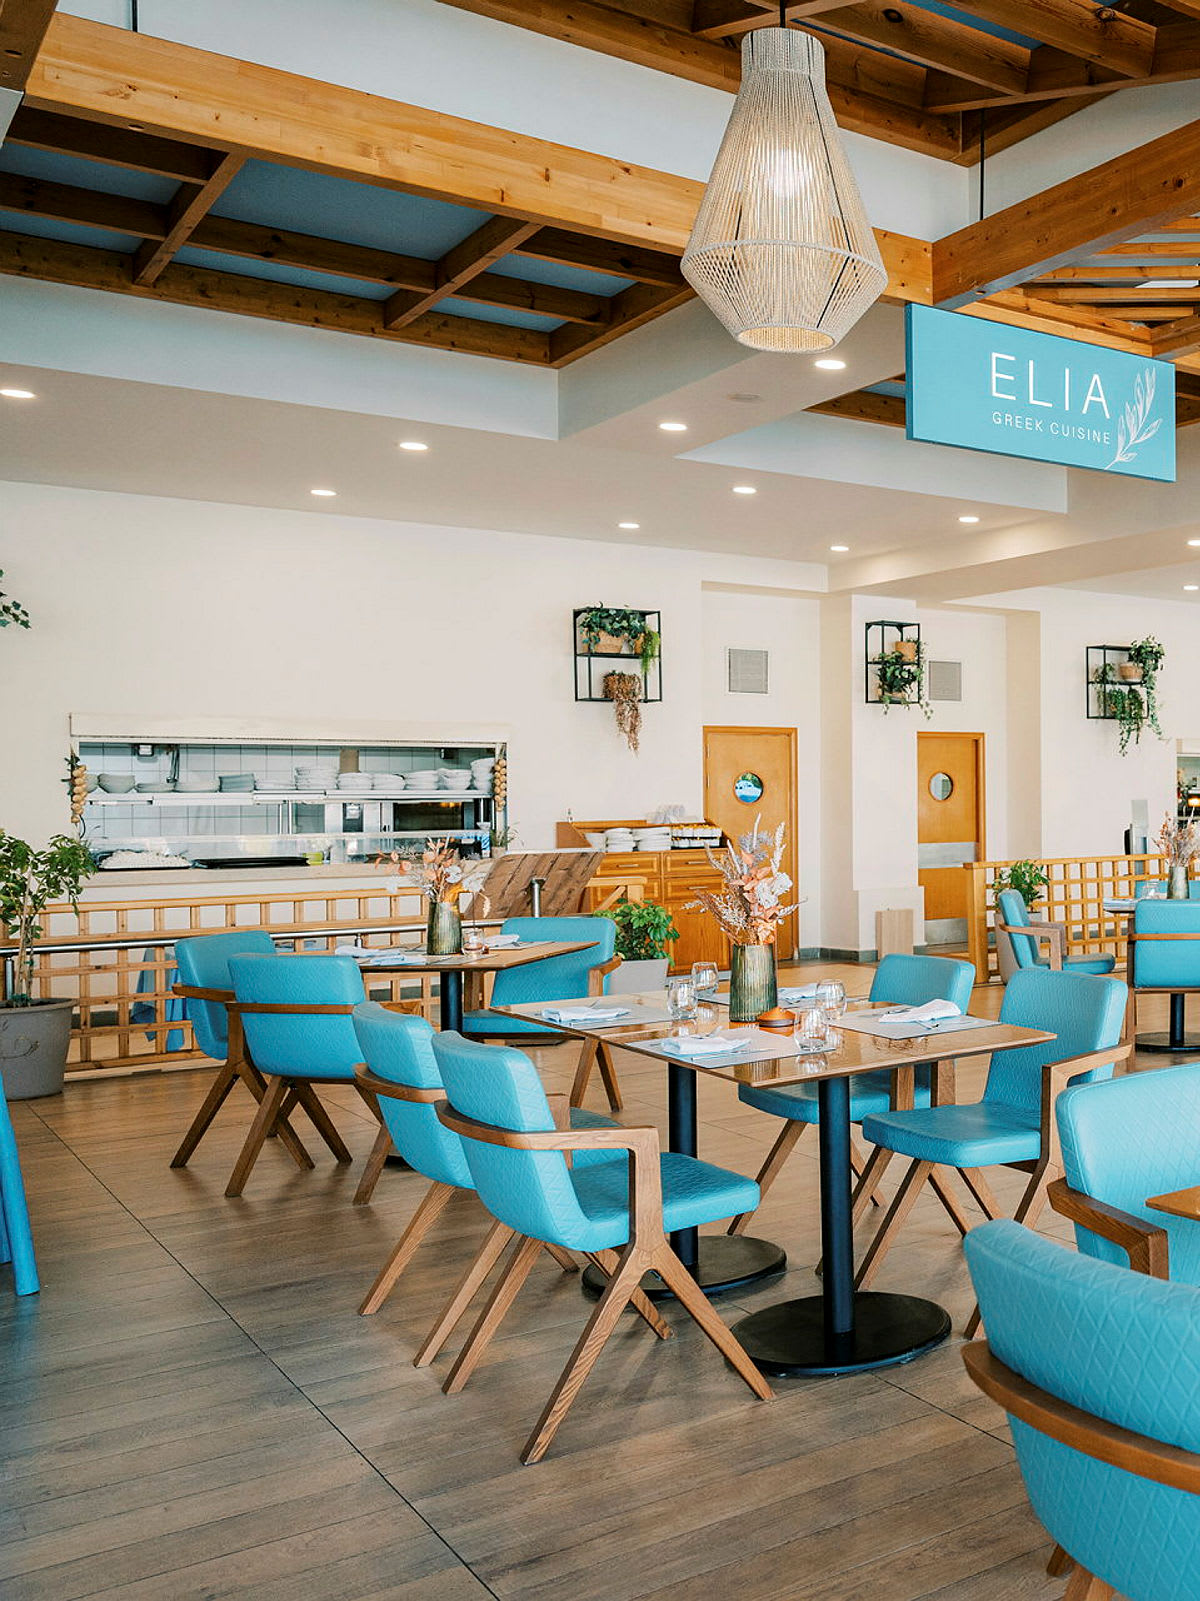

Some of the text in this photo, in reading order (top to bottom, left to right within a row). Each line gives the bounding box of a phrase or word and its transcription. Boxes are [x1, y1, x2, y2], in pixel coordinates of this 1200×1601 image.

[991, 351, 1110, 419] ELIA
[992, 411, 1111, 445] GREEK CUISINE
